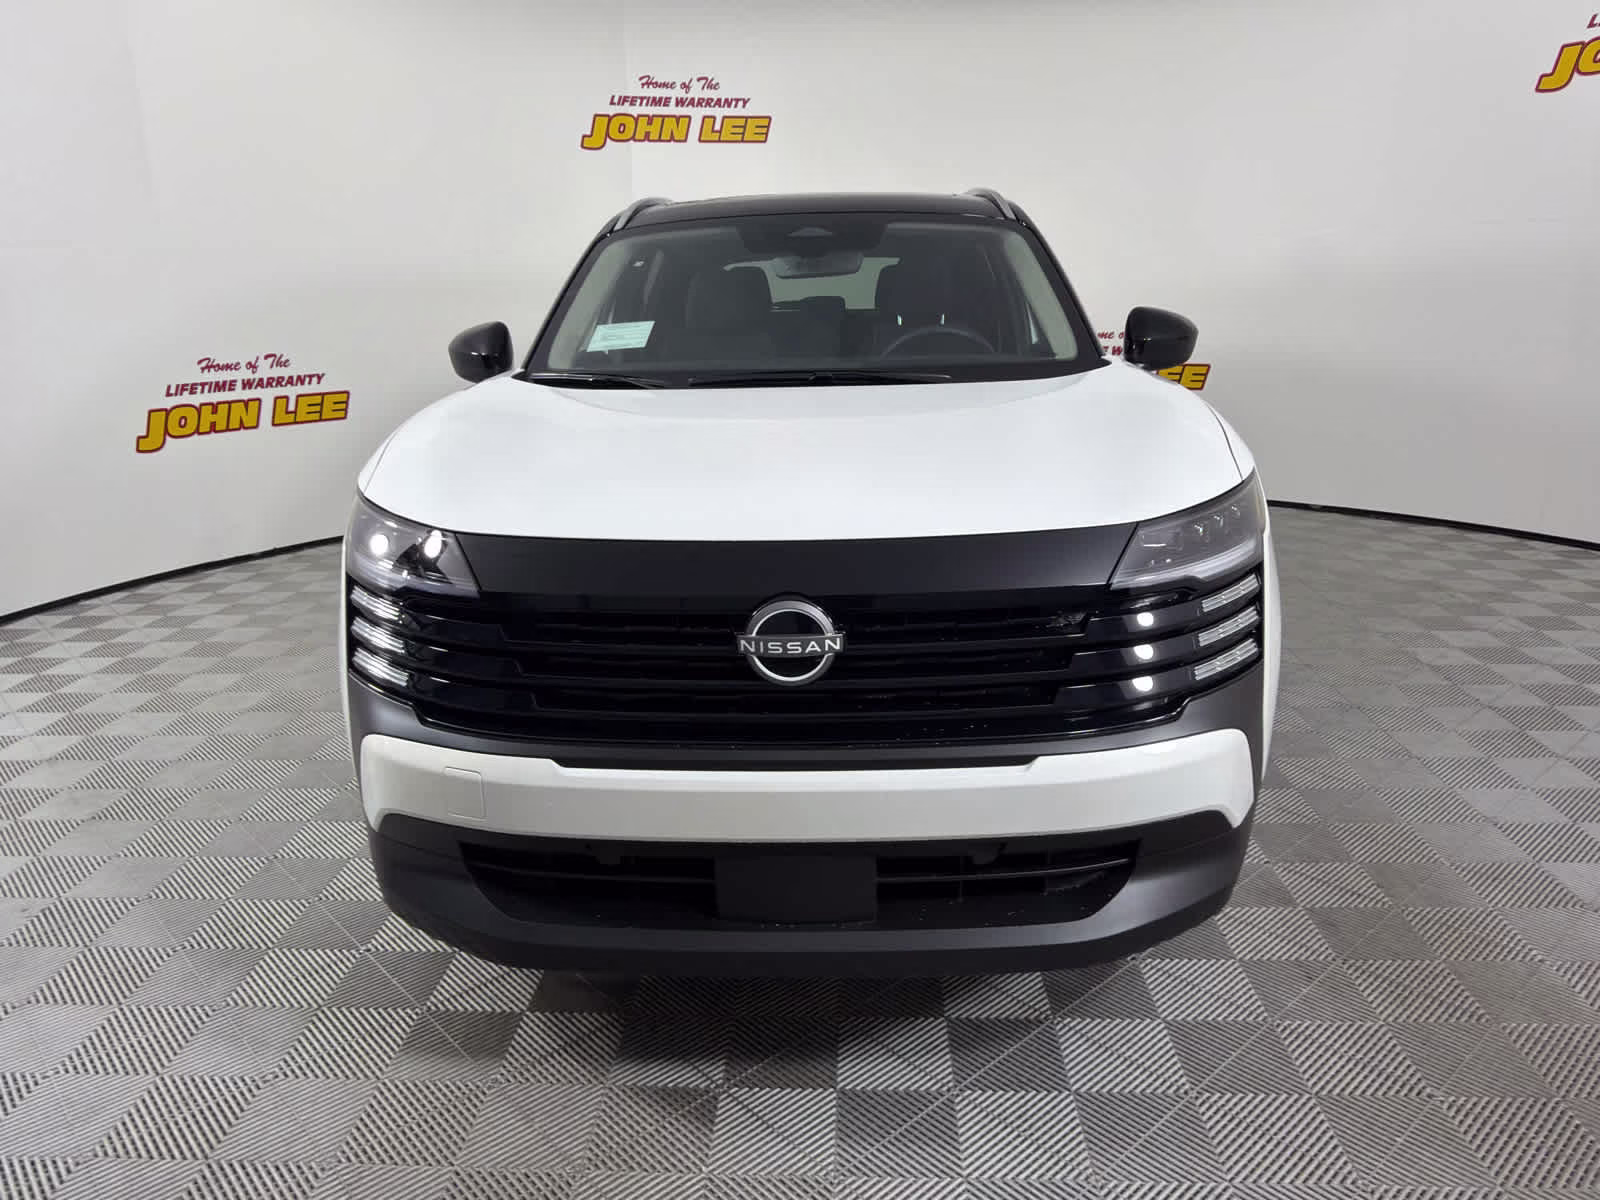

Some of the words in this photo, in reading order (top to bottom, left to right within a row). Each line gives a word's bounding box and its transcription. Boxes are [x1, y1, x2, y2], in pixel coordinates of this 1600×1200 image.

[638, 75, 677, 90] Home
[680, 77, 693, 94] of
[696, 76, 720, 91] The
[609, 95, 671, 108] LIFETIME
[674, 97, 750, 109] WARRANTY
[581, 113, 691, 150] JOHN
[698, 115, 772, 143] LEE
[197, 356, 241, 374] Home
[245, 356, 260, 374] of
[264, 353, 291, 370] The
[165, 378, 238, 398] LIFETIME
[241, 373, 326, 391] WARRANTY
[136, 397, 262, 453] JOHN
[272, 390, 350, 426] LEE
[740, 637, 841, 654] NISSAN
